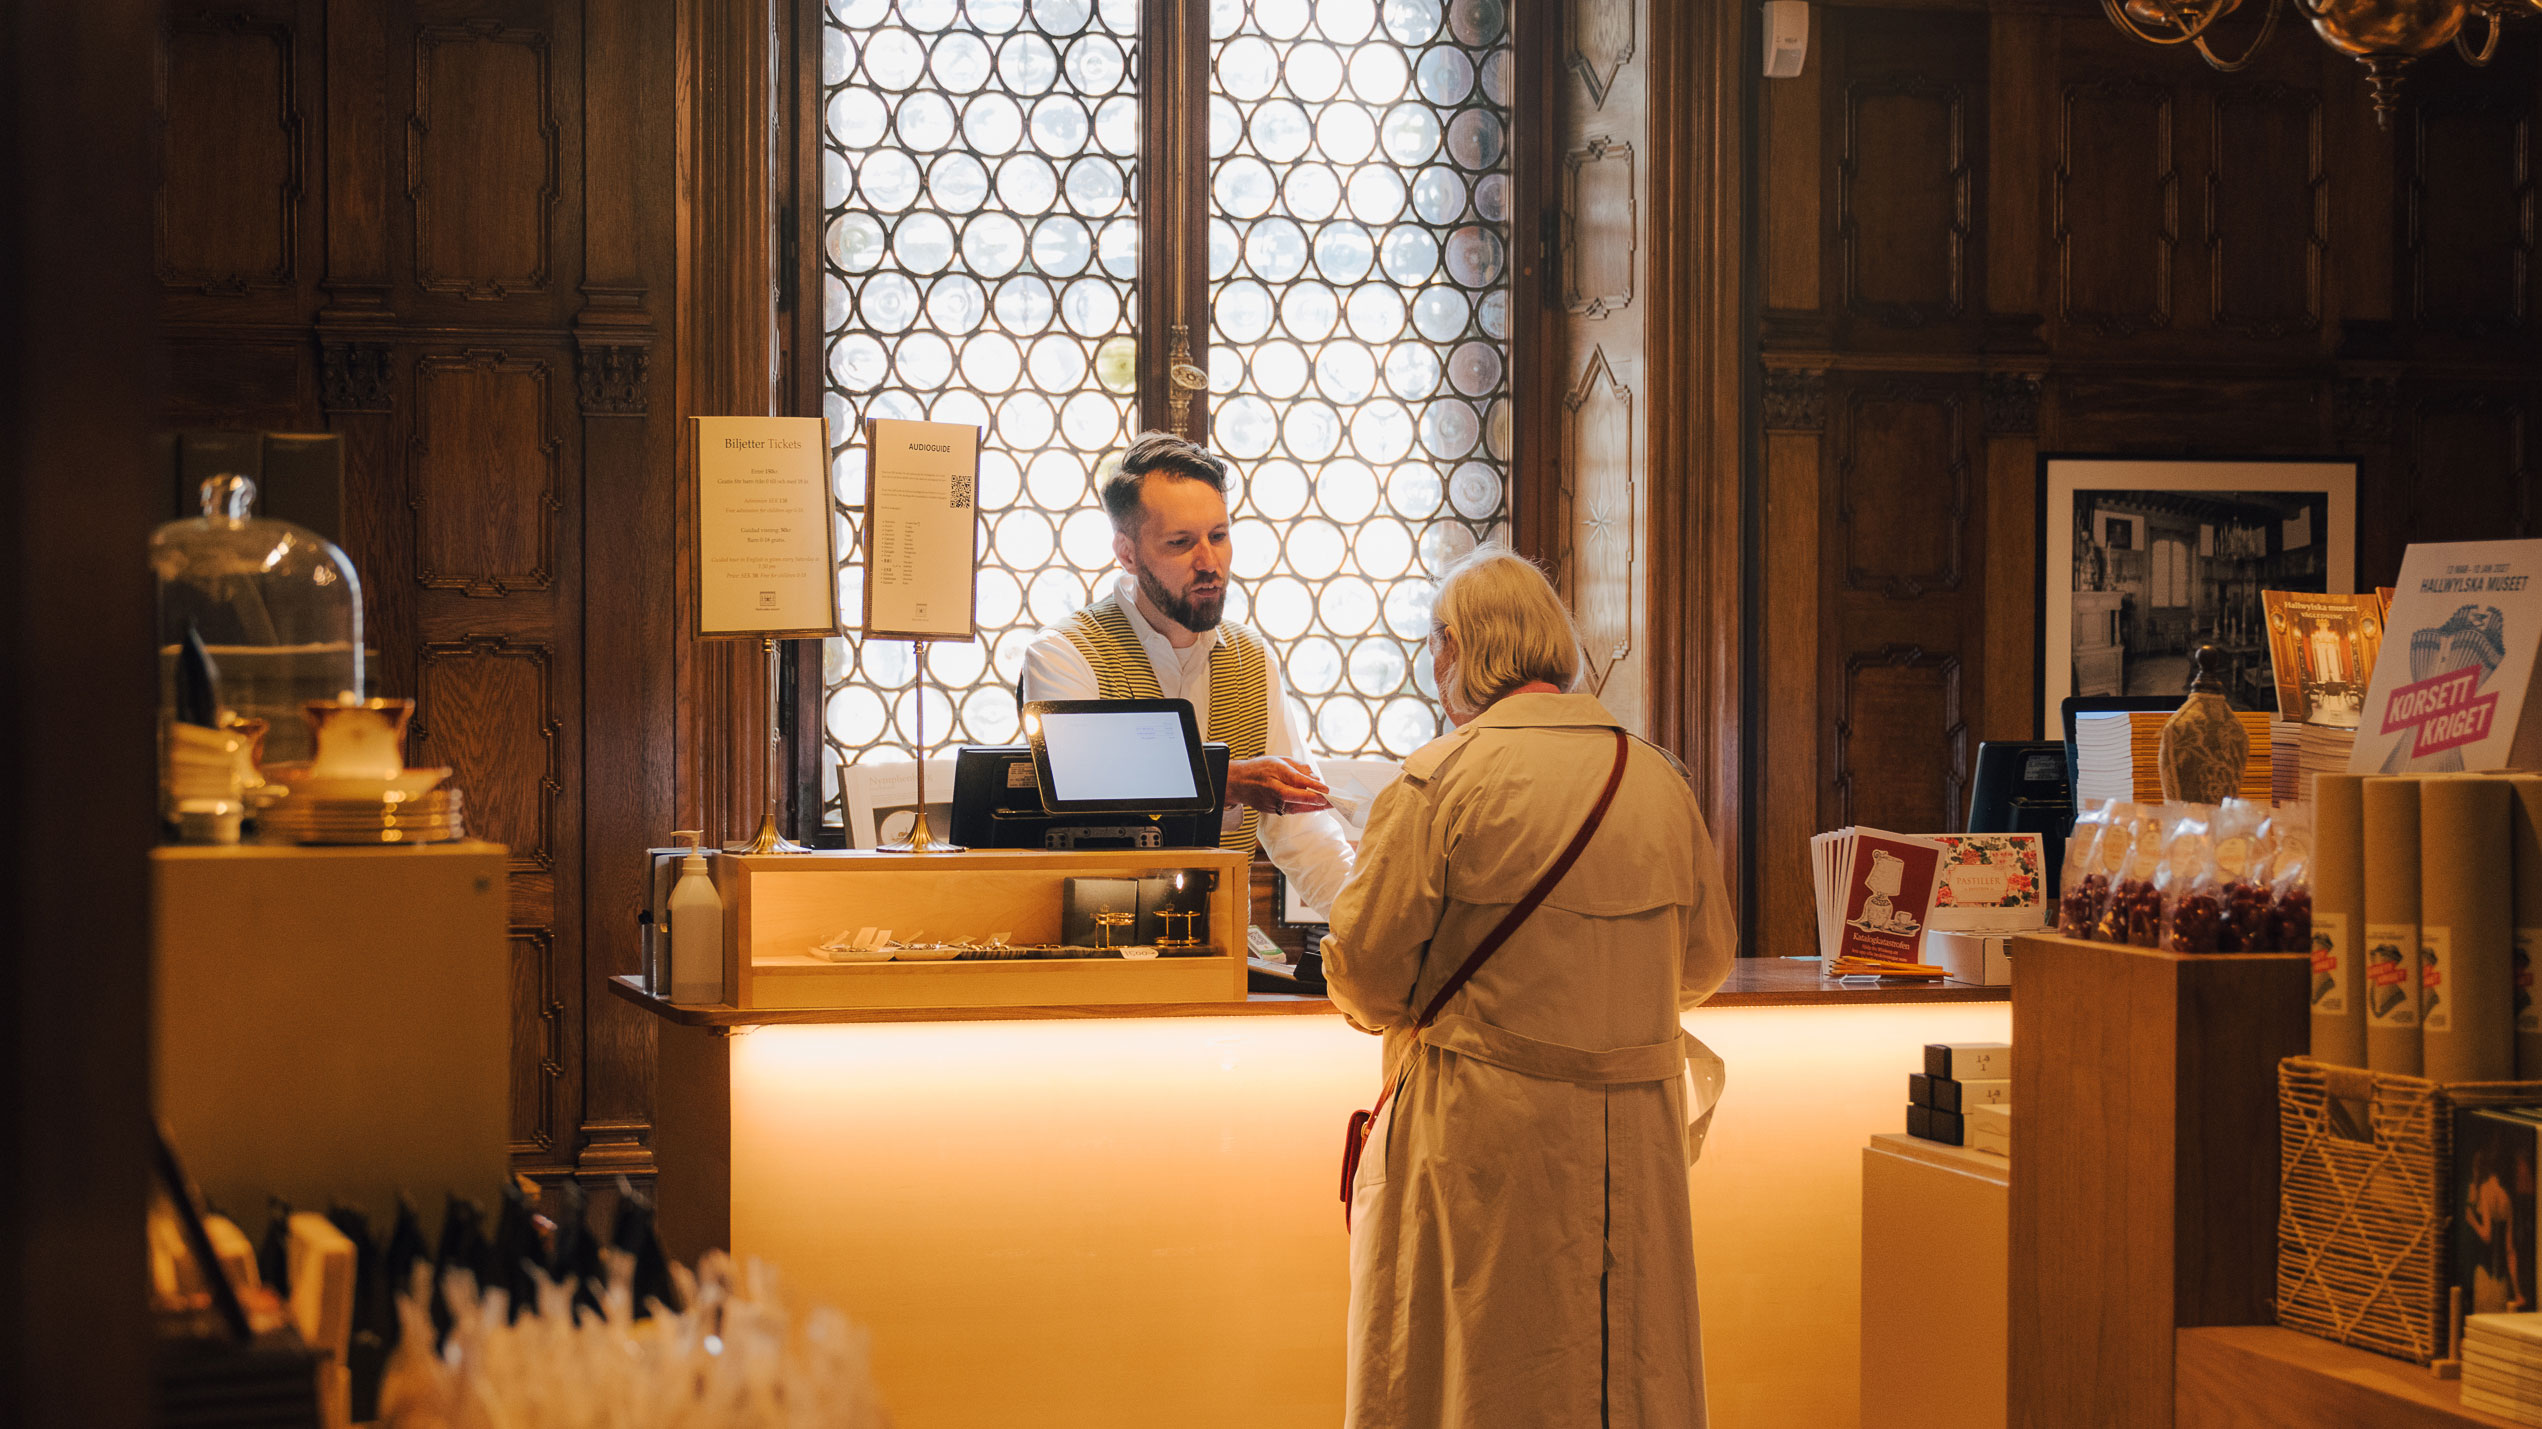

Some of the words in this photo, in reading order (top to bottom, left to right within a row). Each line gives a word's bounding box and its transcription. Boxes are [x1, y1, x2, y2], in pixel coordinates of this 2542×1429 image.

[725, 438, 765, 452] Biljetter
[768, 438, 802, 449] Tickets
[908, 443, 951, 453] AUDIOGUIDE
[2420, 577, 2484, 593] HALLWYLSKA
[2486, 576, 2529, 591] MUSEET
[2284, 601, 2328, 612] Hallwylska
[2388, 674, 2474, 725] KORSETT
[2420, 702, 2492, 748] KRIGET
[1956, 877, 2001, 885] PASTILLER
[1853, 932, 1910, 950] Katalogkatastrofen
